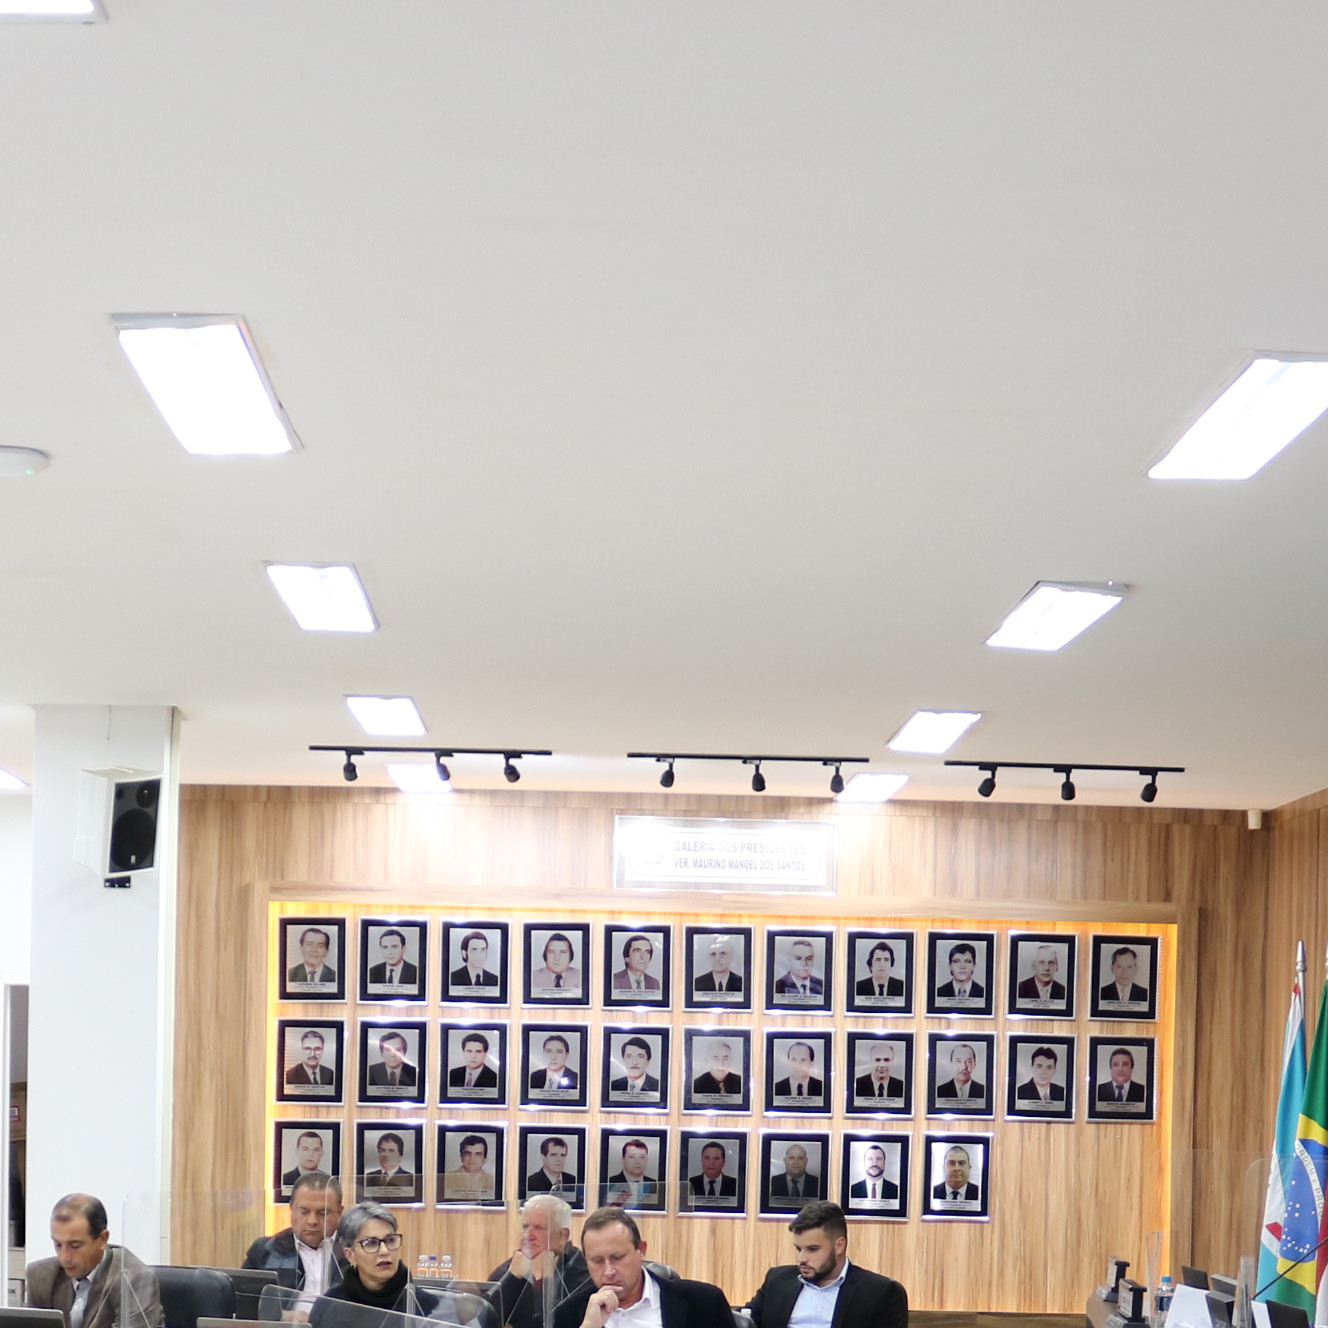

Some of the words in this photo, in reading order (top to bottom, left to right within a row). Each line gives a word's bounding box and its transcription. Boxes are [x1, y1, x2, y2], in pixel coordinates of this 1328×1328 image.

[674, 840, 715, 852] GALERIA
[674, 857, 690, 869] VER.
[693, 858, 726, 869] MAURINO
[728, 859, 757, 870] MANOEL
[760, 860, 774, 870] DOS
[777, 860, 805, 871] SANTOS
